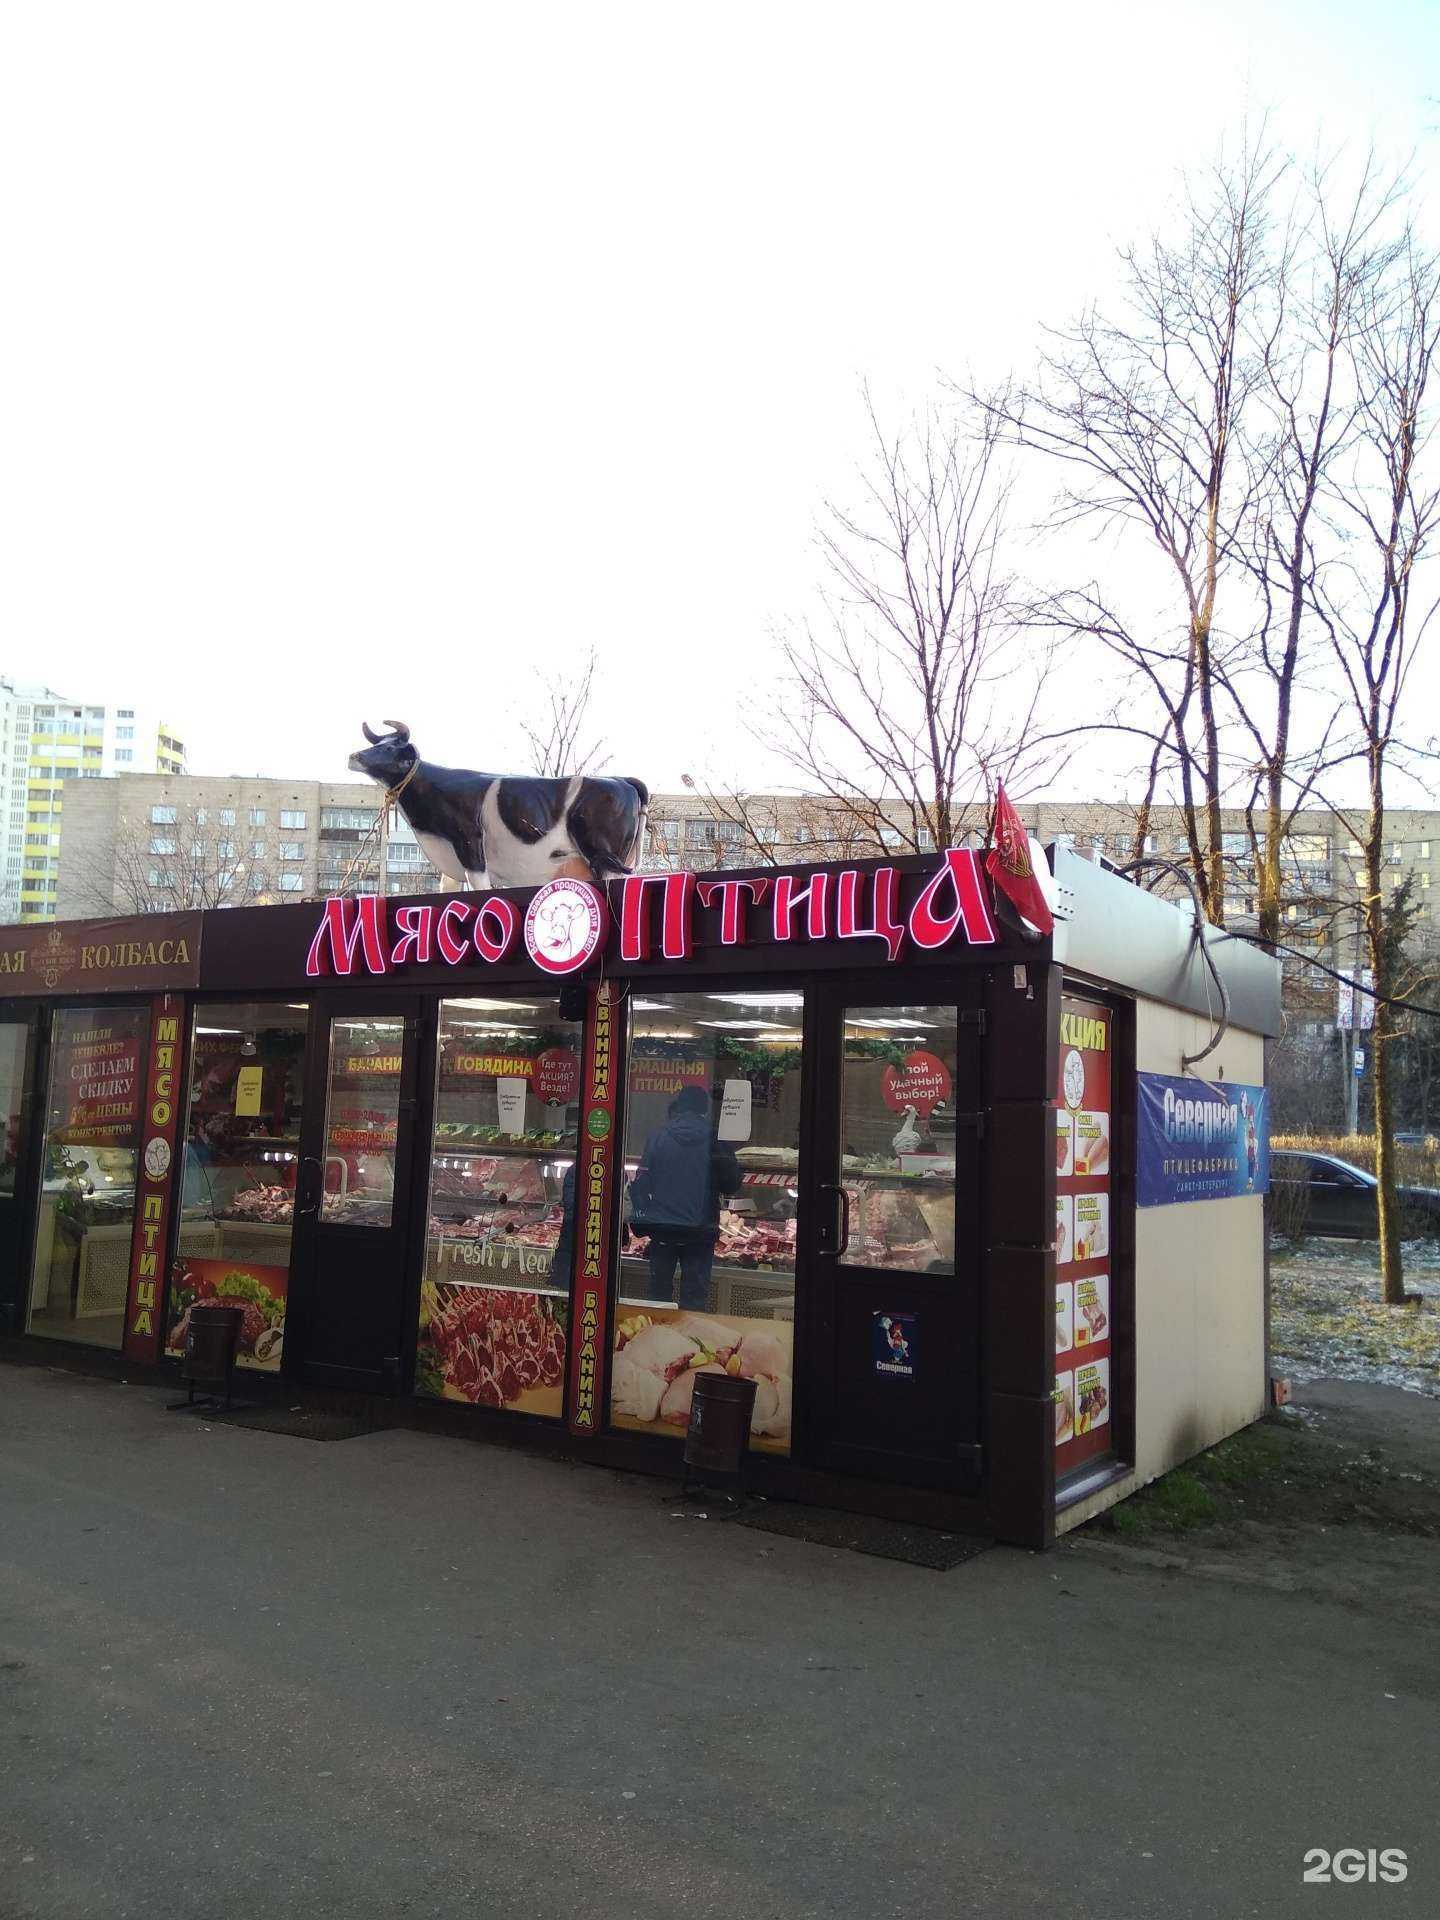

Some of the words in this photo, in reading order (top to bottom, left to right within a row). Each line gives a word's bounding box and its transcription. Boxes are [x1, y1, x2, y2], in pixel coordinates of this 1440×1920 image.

[555, 881, 593, 907] продукция
[589, 907, 598, 928] для
[80, 939, 192, 969] КОЛБАСА
[72, 1028, 112, 1043] НАШЛИ
[593, 988, 611, 1101] ВИНИНА
[71, 1057, 135, 1080] СДЕЛАЕМ
[151, 1018, 178, 1126] МЯСО
[456, 1056, 534, 1076] ГОВЯДИНА
[541, 1058, 555, 1069] Где
[558, 1061, 572, 1070] тут
[79, 1078, 134, 1099] СКИДКУ
[540, 1081, 570, 1093] Везде!
[635, 1078, 683, 1094] ПТИЦА
[890, 1073, 943, 1091] удачный
[895, 1086, 940, 1100] выбор!
[96, 1102, 134, 1118] ЦЕНЫ
[1164, 1088, 1238, 1146] Северная
[1163, 1158, 1239, 1176] ПТИЦЕФАБРИКА
[584, 1147, 605, 1277] ГОВЯДИНА
[437, 1233, 494, 1267] Fresh
[132, 1195, 163, 1335] ПТИЦА
[576, 1291, 598, 1427] БАРАНИНА
